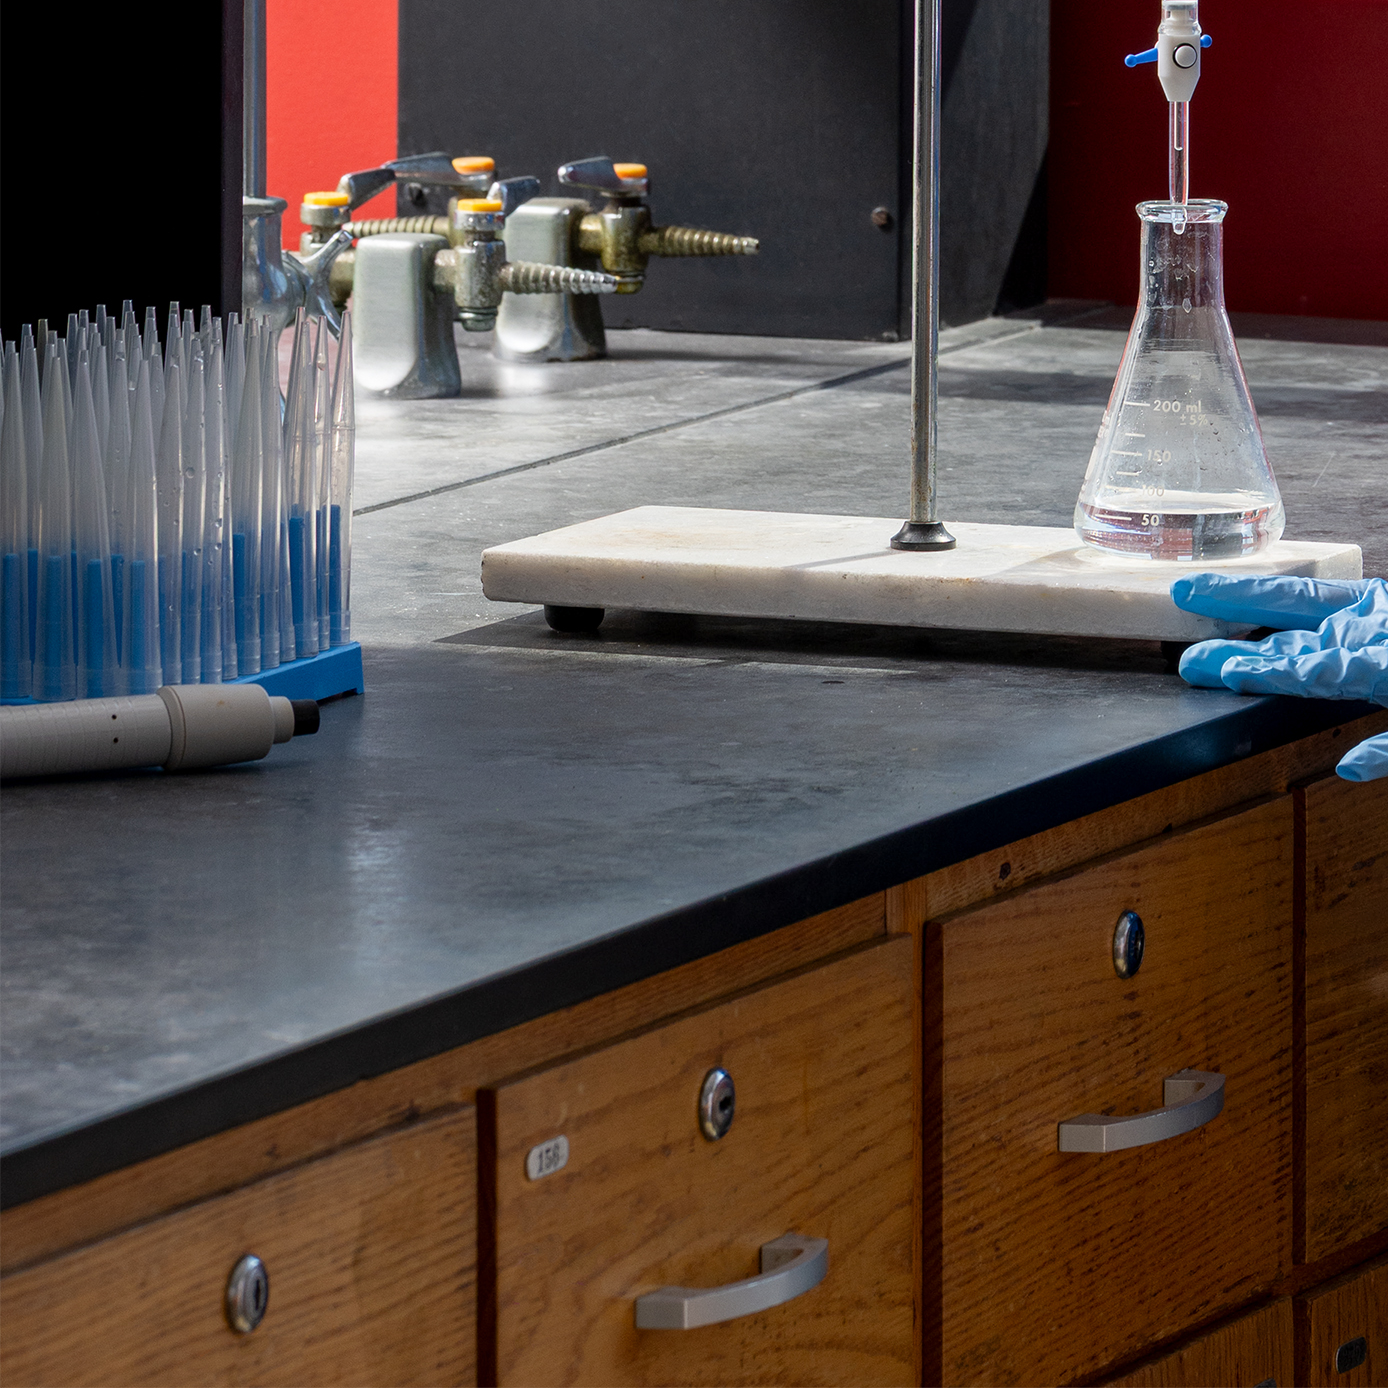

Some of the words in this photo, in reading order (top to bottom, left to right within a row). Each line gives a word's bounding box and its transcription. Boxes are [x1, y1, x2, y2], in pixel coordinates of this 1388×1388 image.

[1153, 399, 1181, 413] 200
[1185, 399, 1202, 413] ml
[1147, 449, 1171, 463] 150
[1140, 513, 1160, 527] 50
